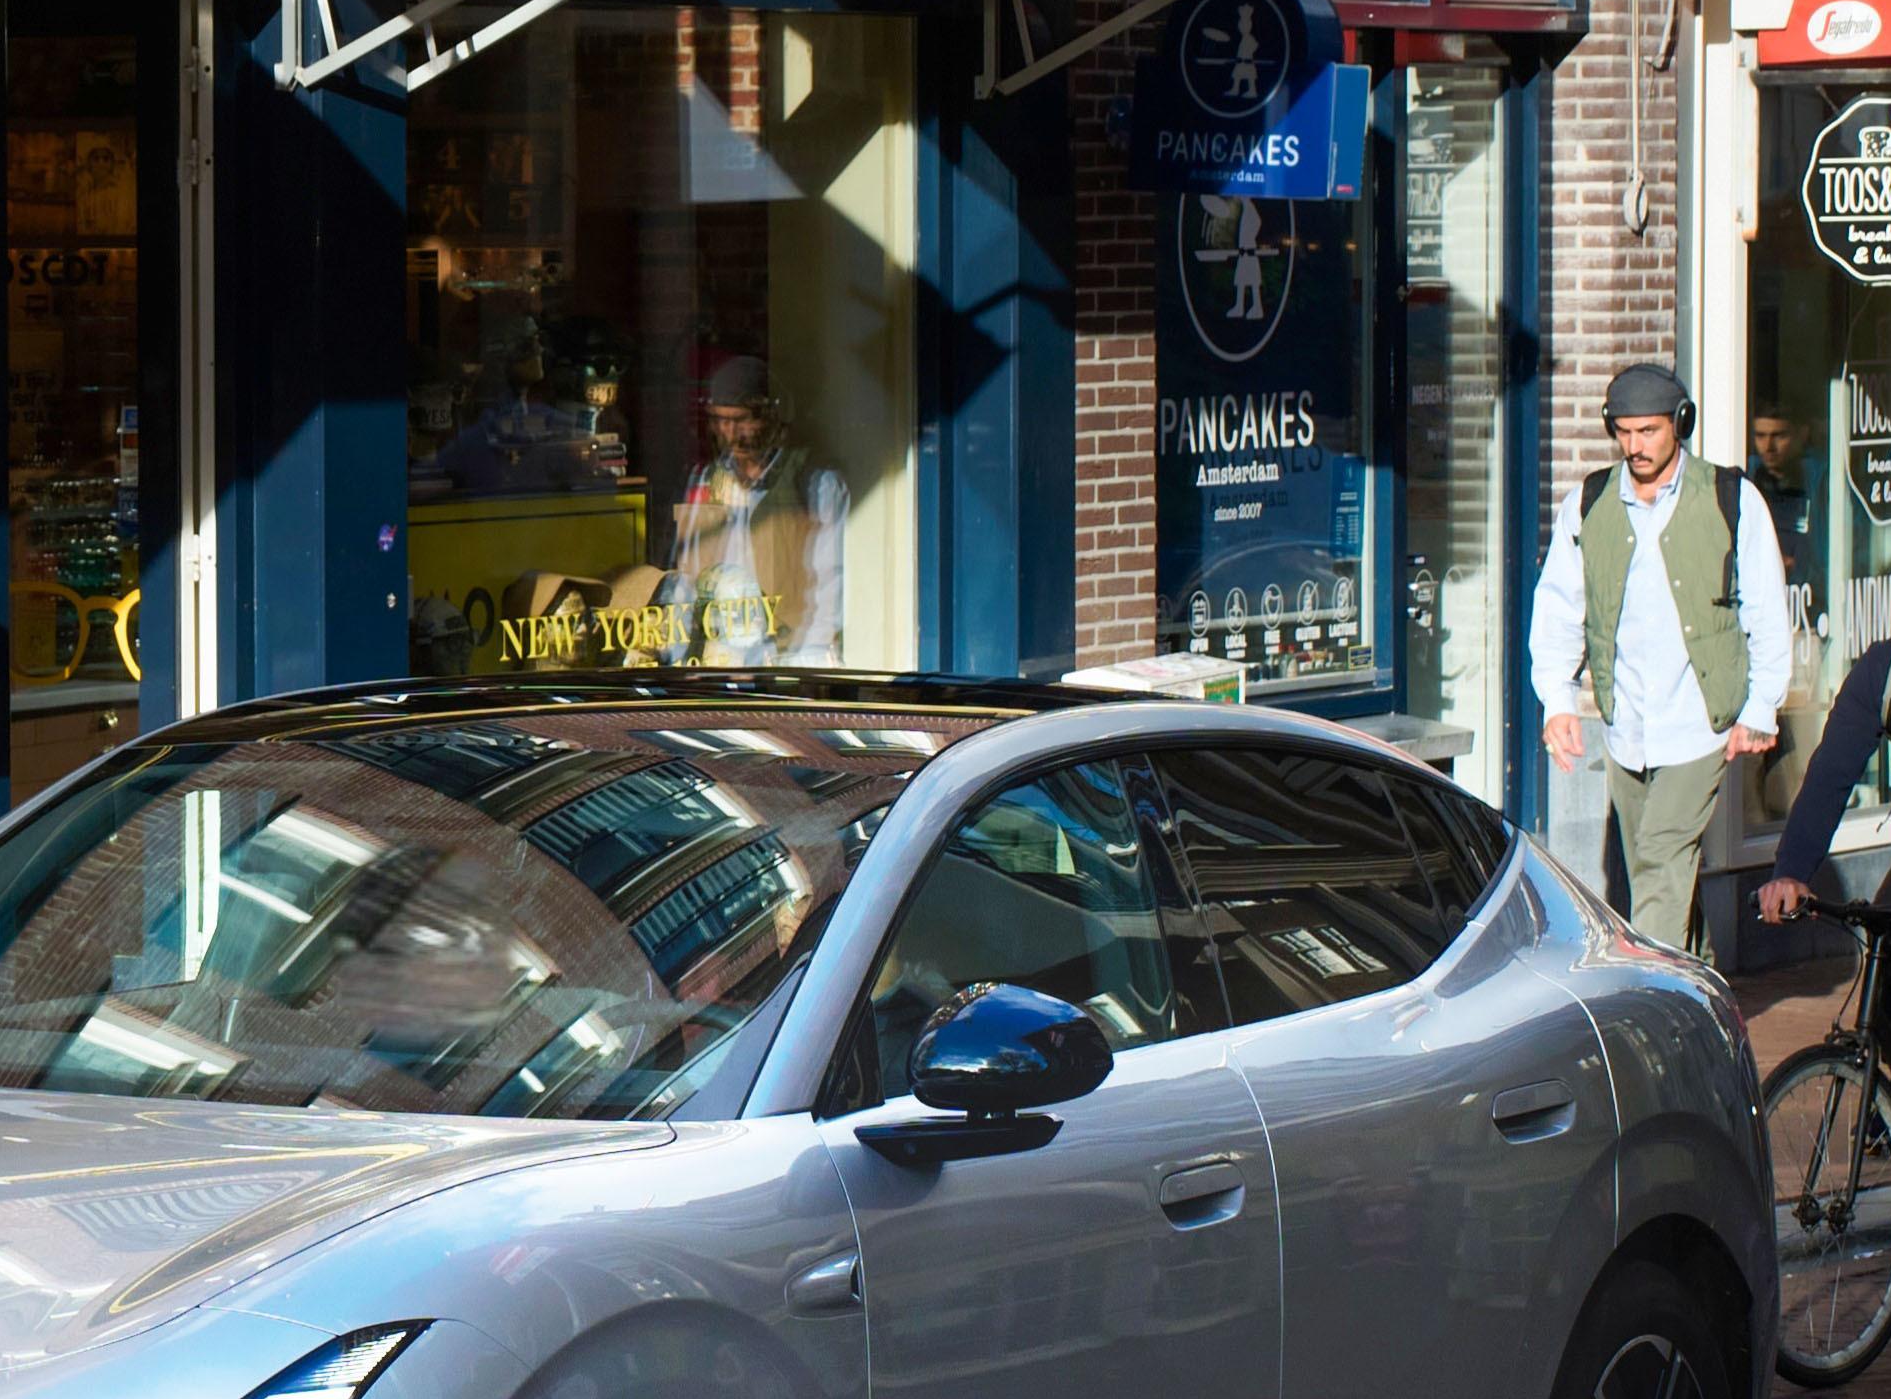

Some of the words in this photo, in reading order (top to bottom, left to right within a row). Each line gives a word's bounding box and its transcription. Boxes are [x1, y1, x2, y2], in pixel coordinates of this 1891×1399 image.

[1158, 131, 1300, 167] PANCAKES
[1853, 246, 1869, 264] &
[1161, 390, 1315, 455] PANCAKES
[1196, 461, 1279, 487] Amsterdam
[1214, 506, 1238, 522] since
[1238, 503, 1263, 518] 2007
[499, 614, 582, 662] NEW
[596, 604, 690, 651] YORK
[702, 595, 782, 642] CITY
